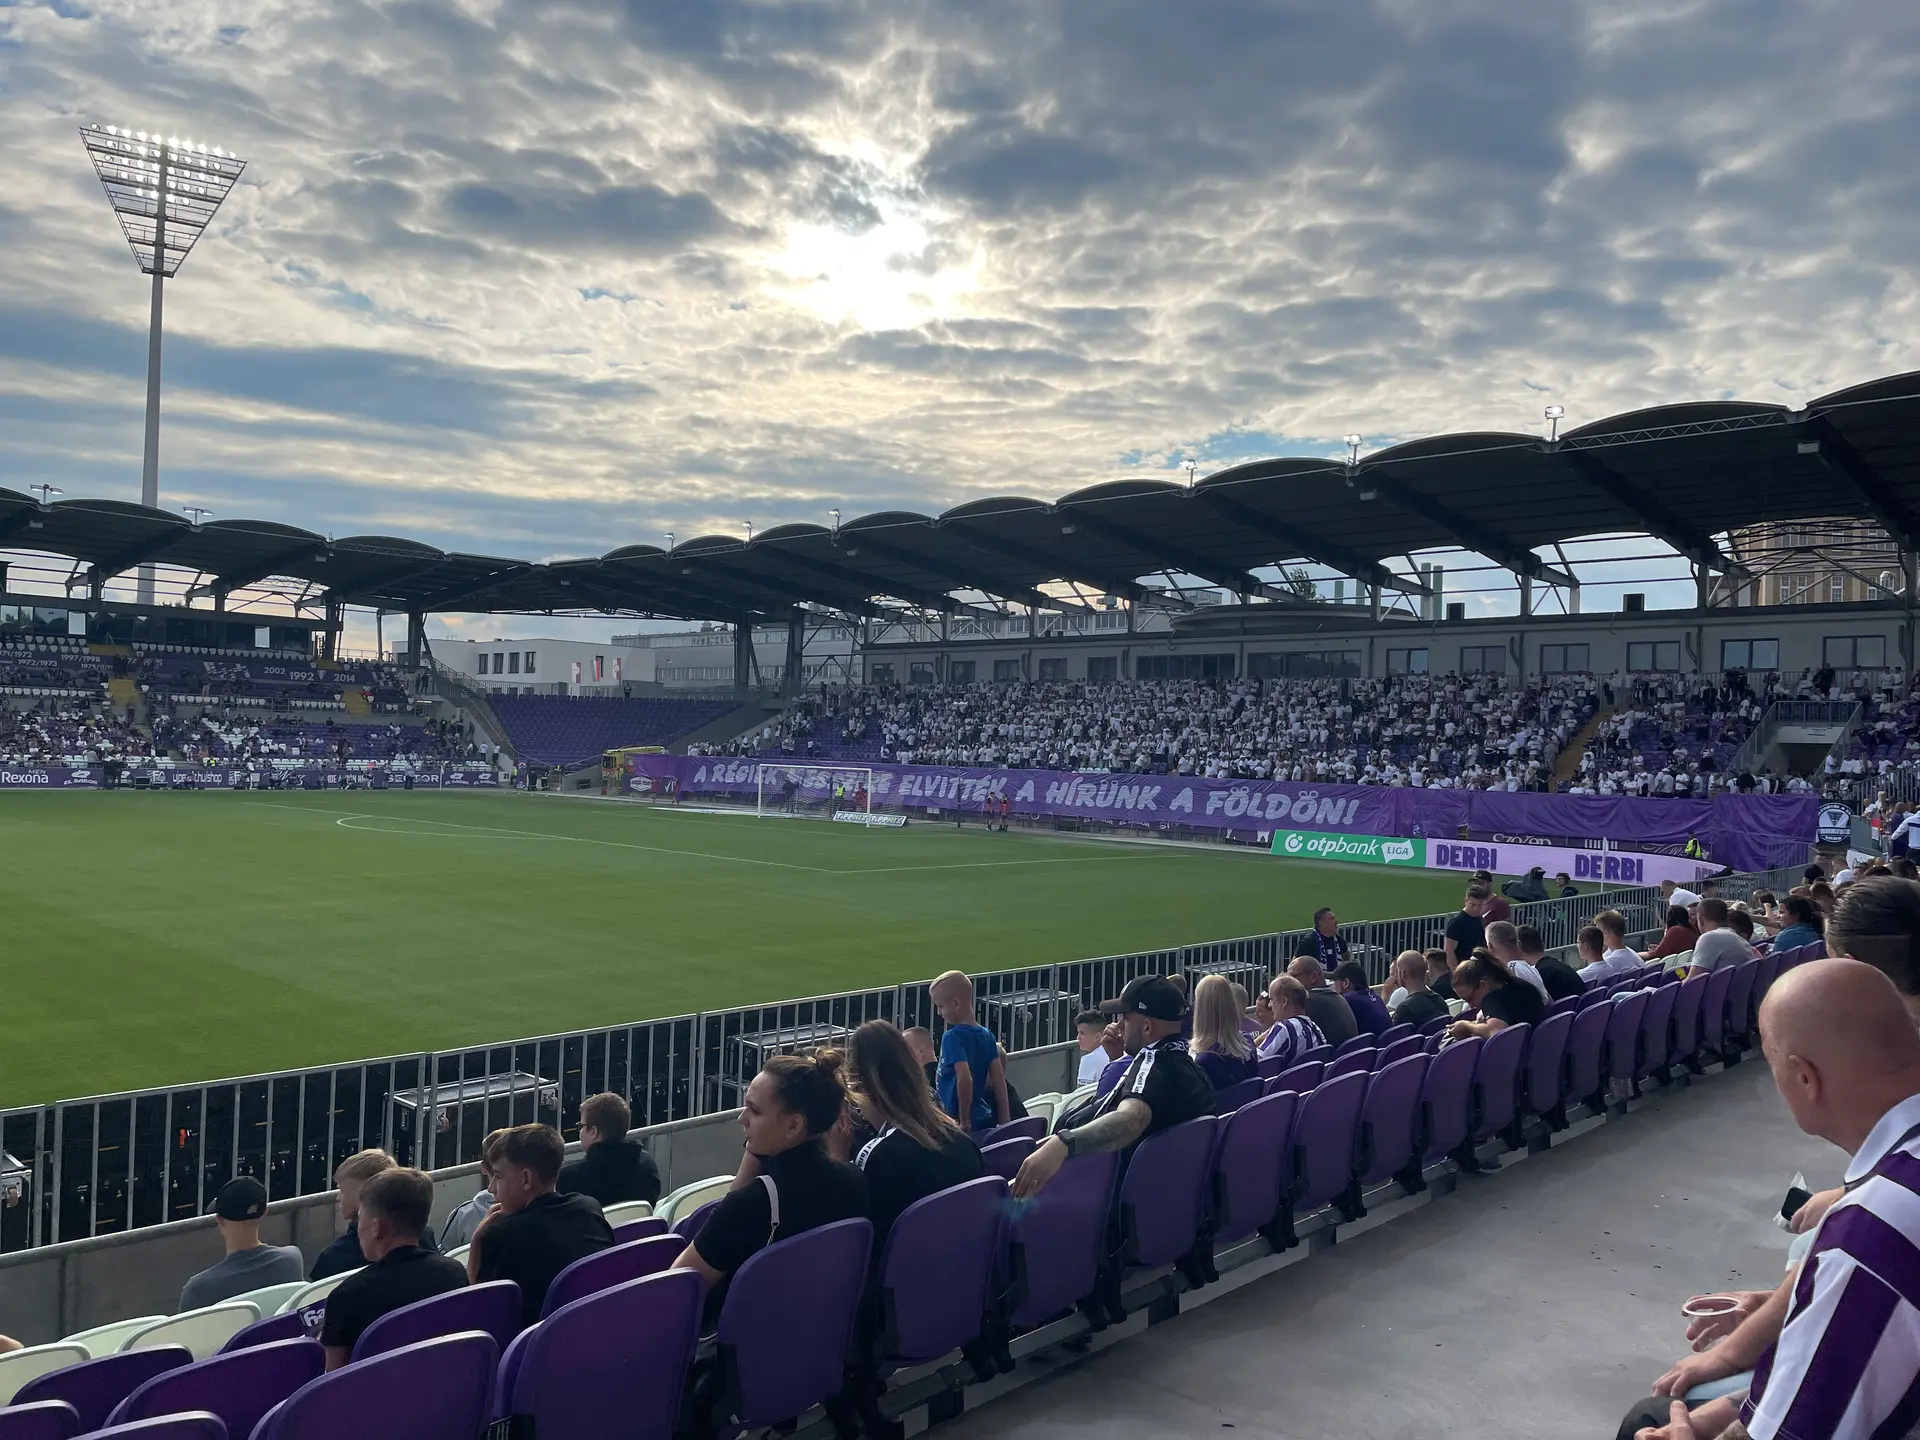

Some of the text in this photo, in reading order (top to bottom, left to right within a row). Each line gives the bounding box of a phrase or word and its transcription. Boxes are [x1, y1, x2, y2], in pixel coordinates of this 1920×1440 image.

[263, 666, 286, 675] 2002
[289, 671, 315, 681] 1992
[333, 673, 356, 683] 2014
[1, 773, 49, 784] Rexona
[693, 765, 707, 784] A
[711, 760, 780, 785] RÉGIEK
[899, 775, 1007, 802] ELVITTÉK
[1015, 779, 1035, 802] A
[1046, 776, 1162, 811] HÍRÜNK
[1169, 787, 1194, 813] A
[1205, 785, 1360, 825] FÖLDÖN!
[1306, 836, 1409, 857] otpbank LIGA
[1436, 844, 1498, 871] DERBI
[1575, 854, 1644, 882] DERBI
